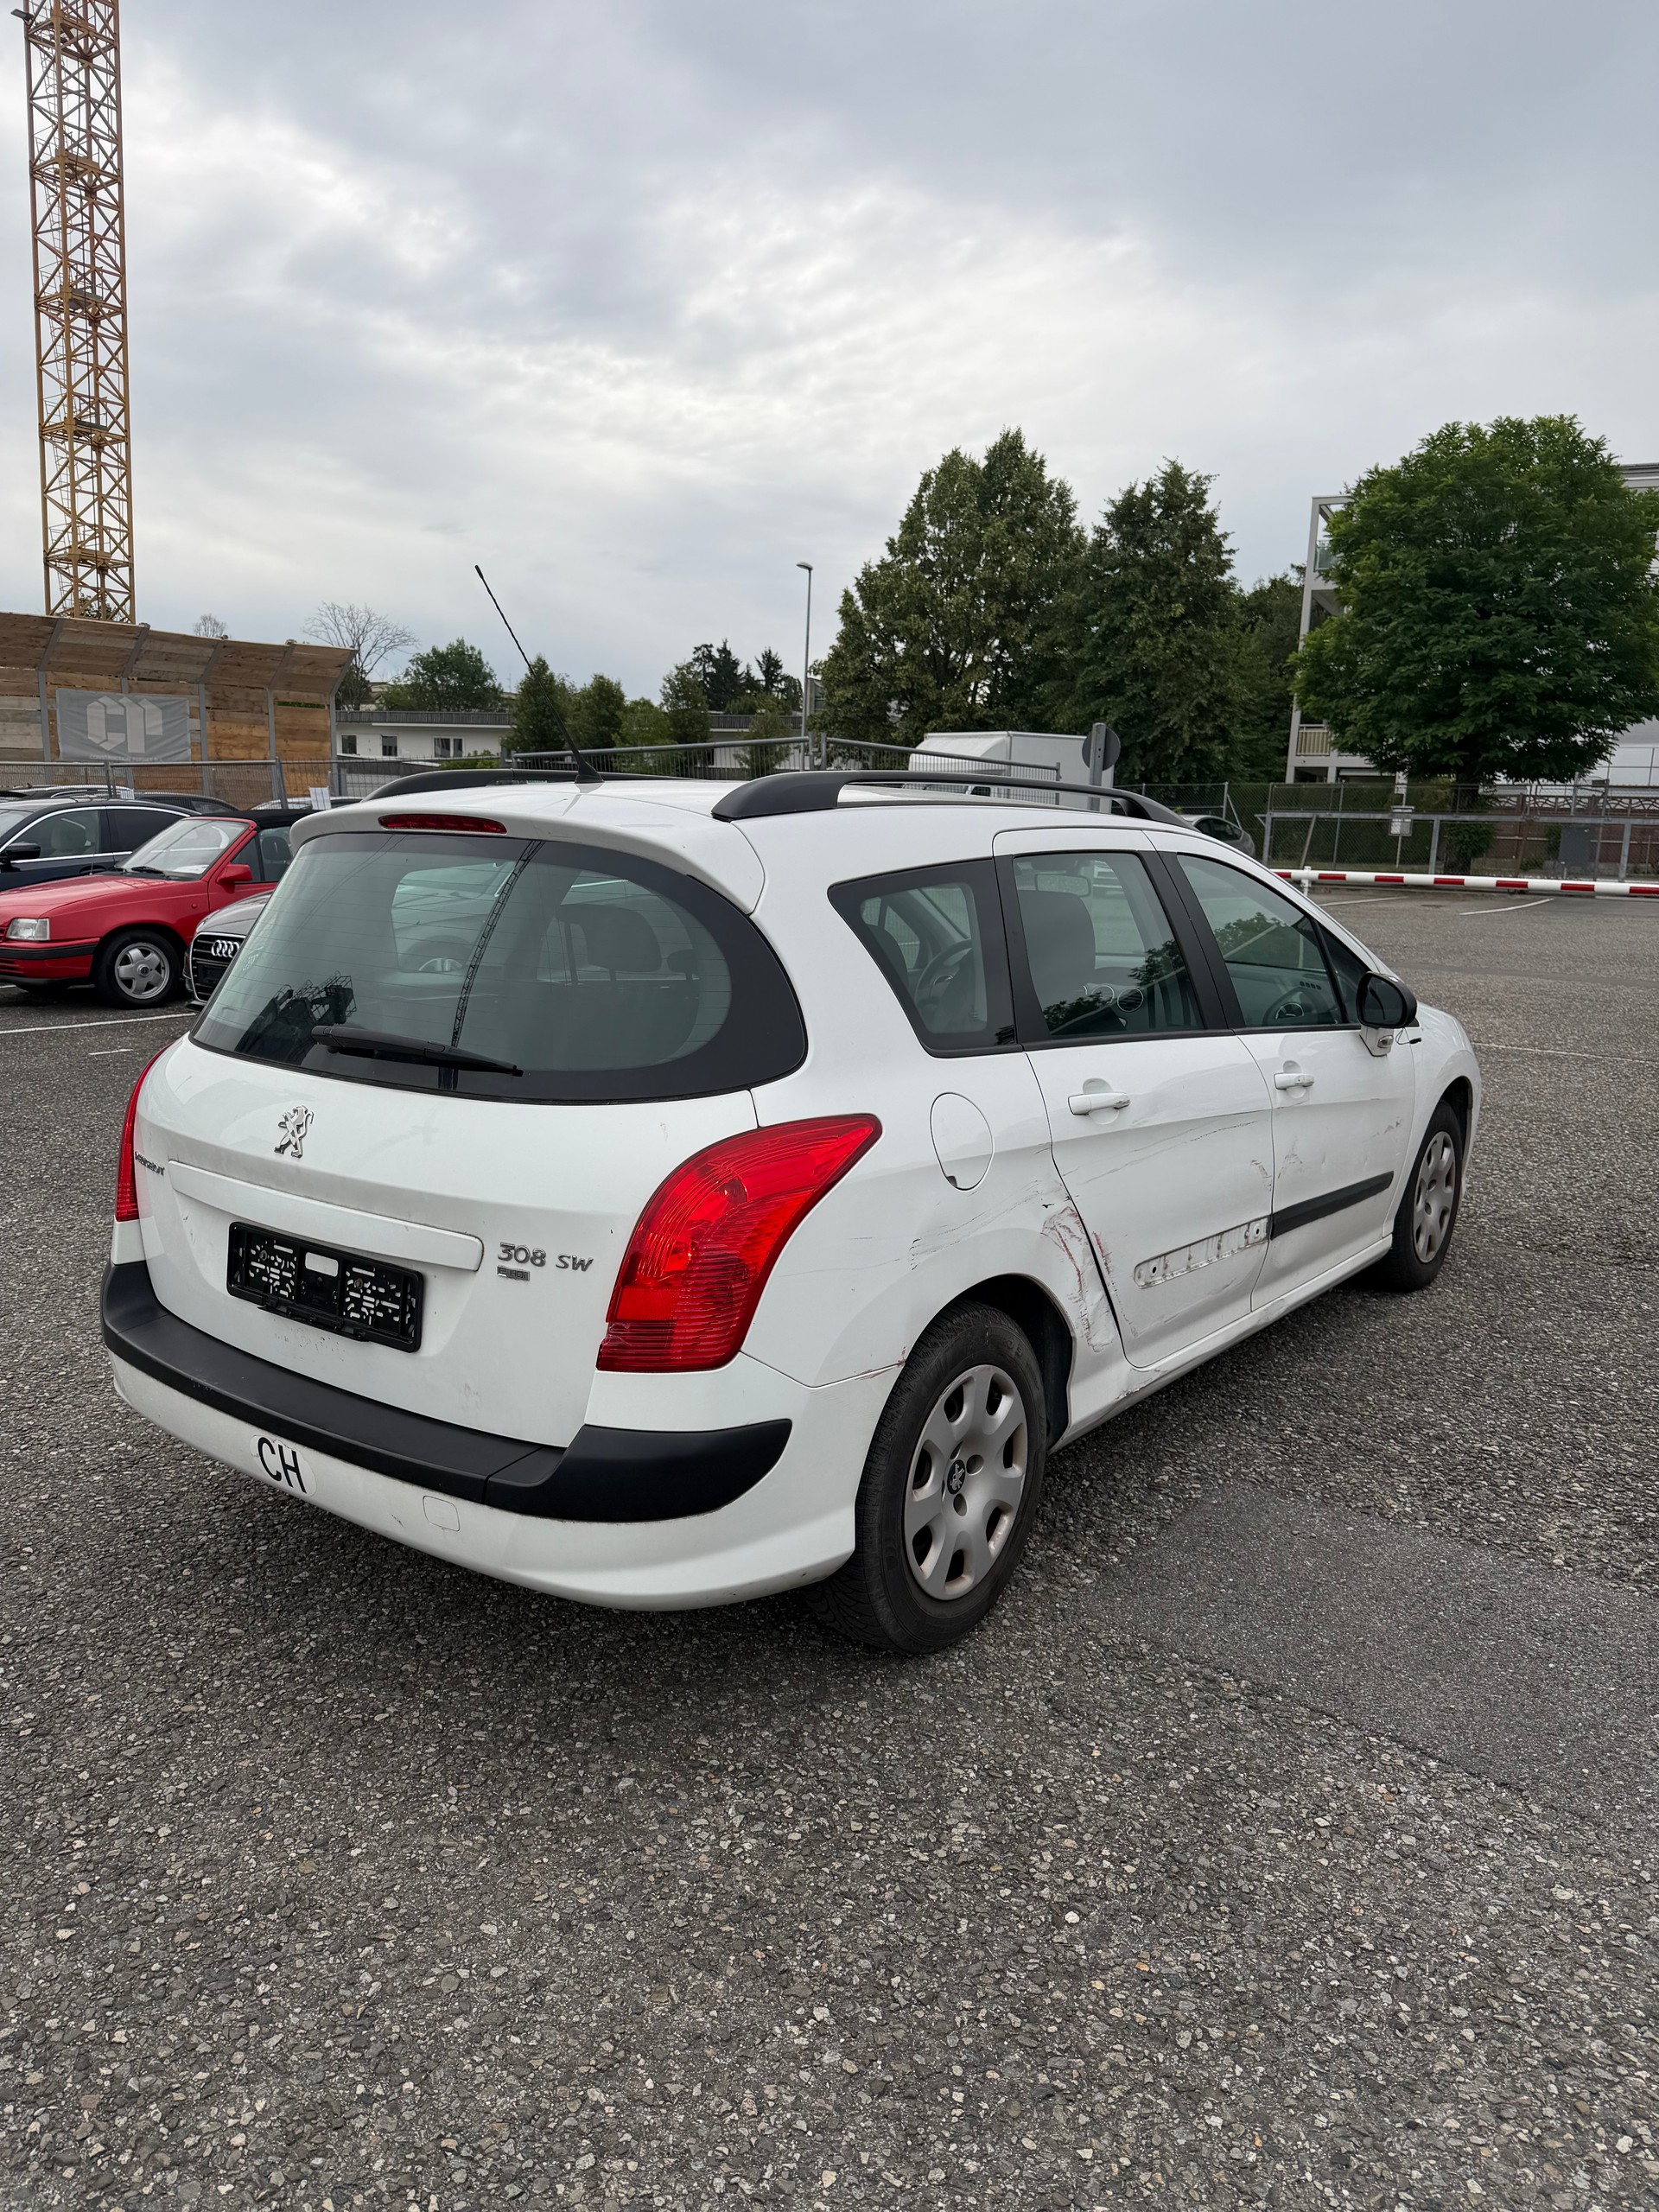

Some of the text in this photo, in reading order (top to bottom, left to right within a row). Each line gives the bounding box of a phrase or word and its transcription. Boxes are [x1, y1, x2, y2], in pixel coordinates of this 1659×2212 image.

[498, 1242, 594, 1272] 308 SW
[257, 1437, 308, 1494] CH
